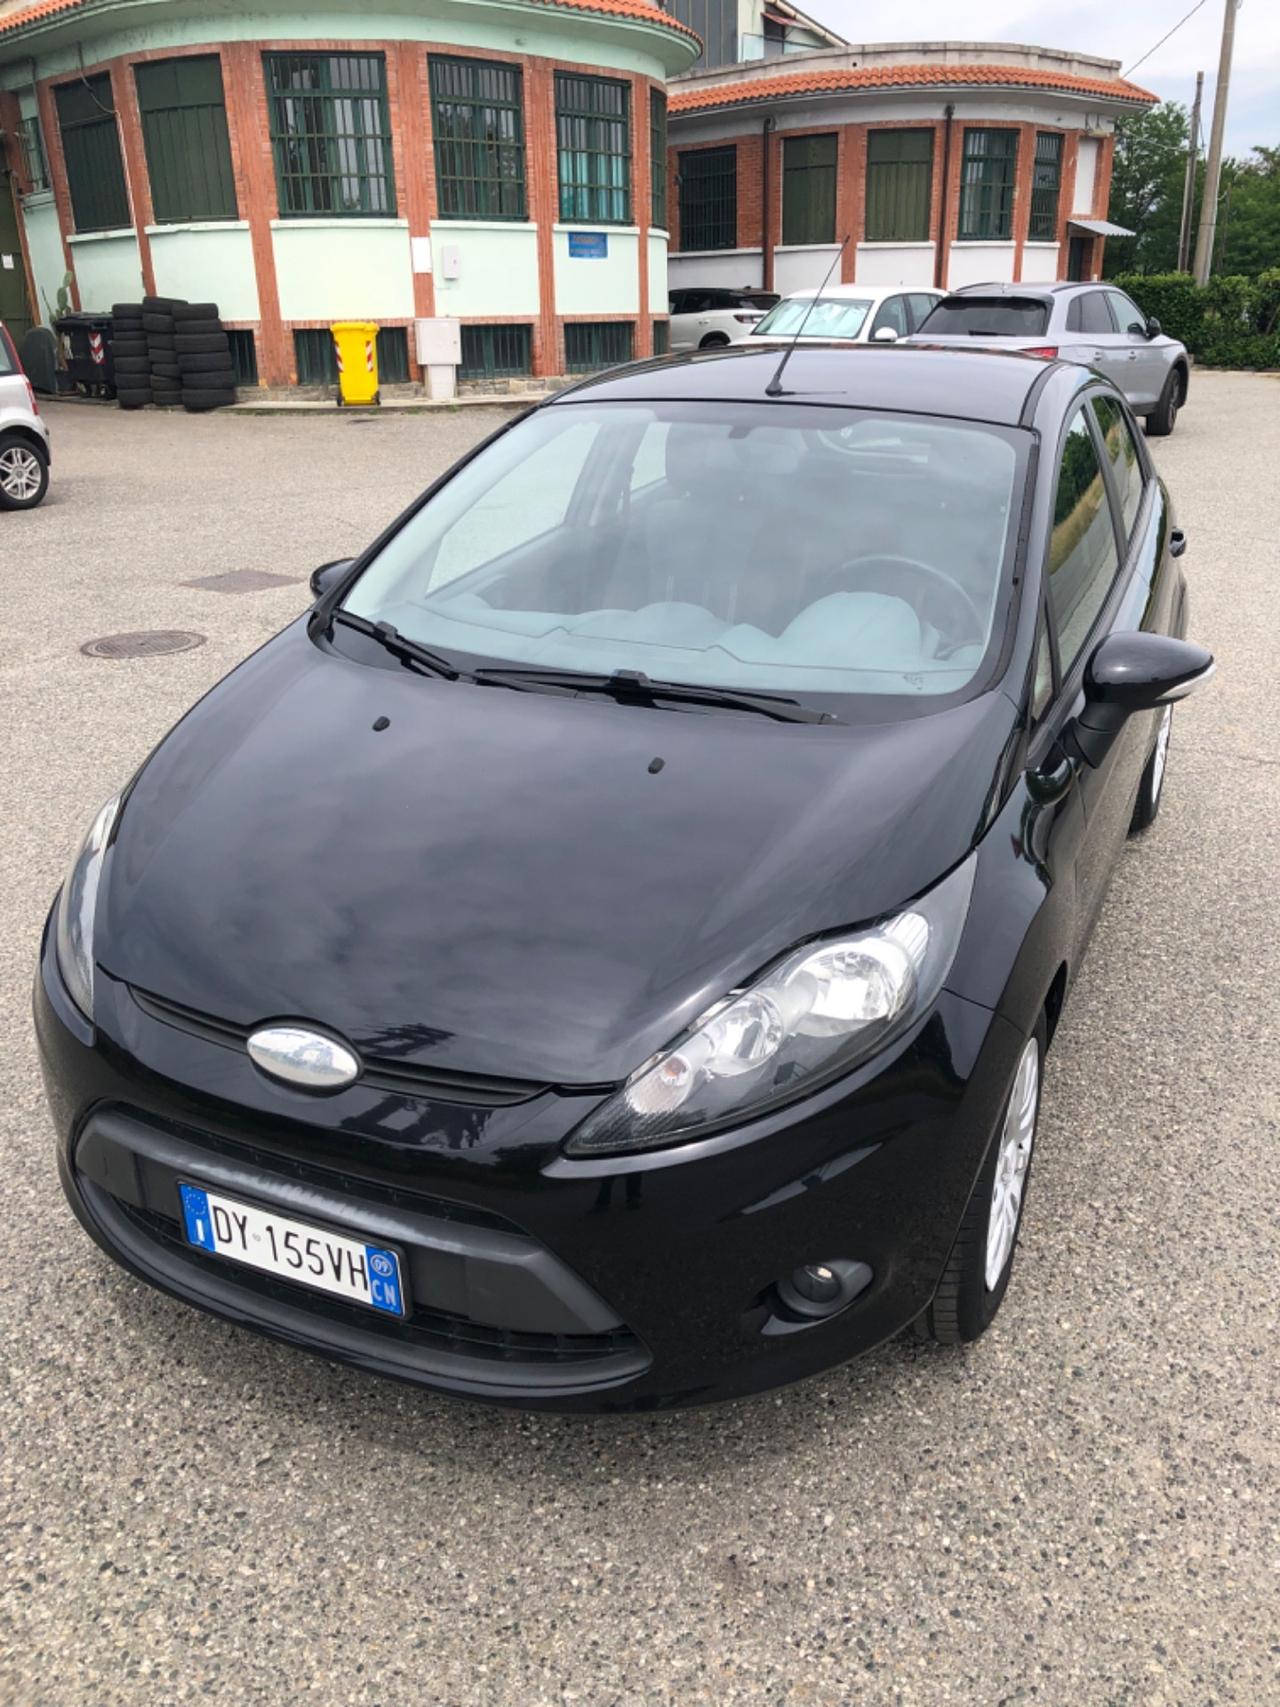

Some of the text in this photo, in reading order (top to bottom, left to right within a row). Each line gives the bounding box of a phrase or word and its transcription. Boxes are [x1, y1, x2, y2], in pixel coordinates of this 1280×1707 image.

[196, 1218, 205, 1242] I
[212, 1205, 369, 1291] DY 155VH
[371, 1279, 397, 1306] CN
